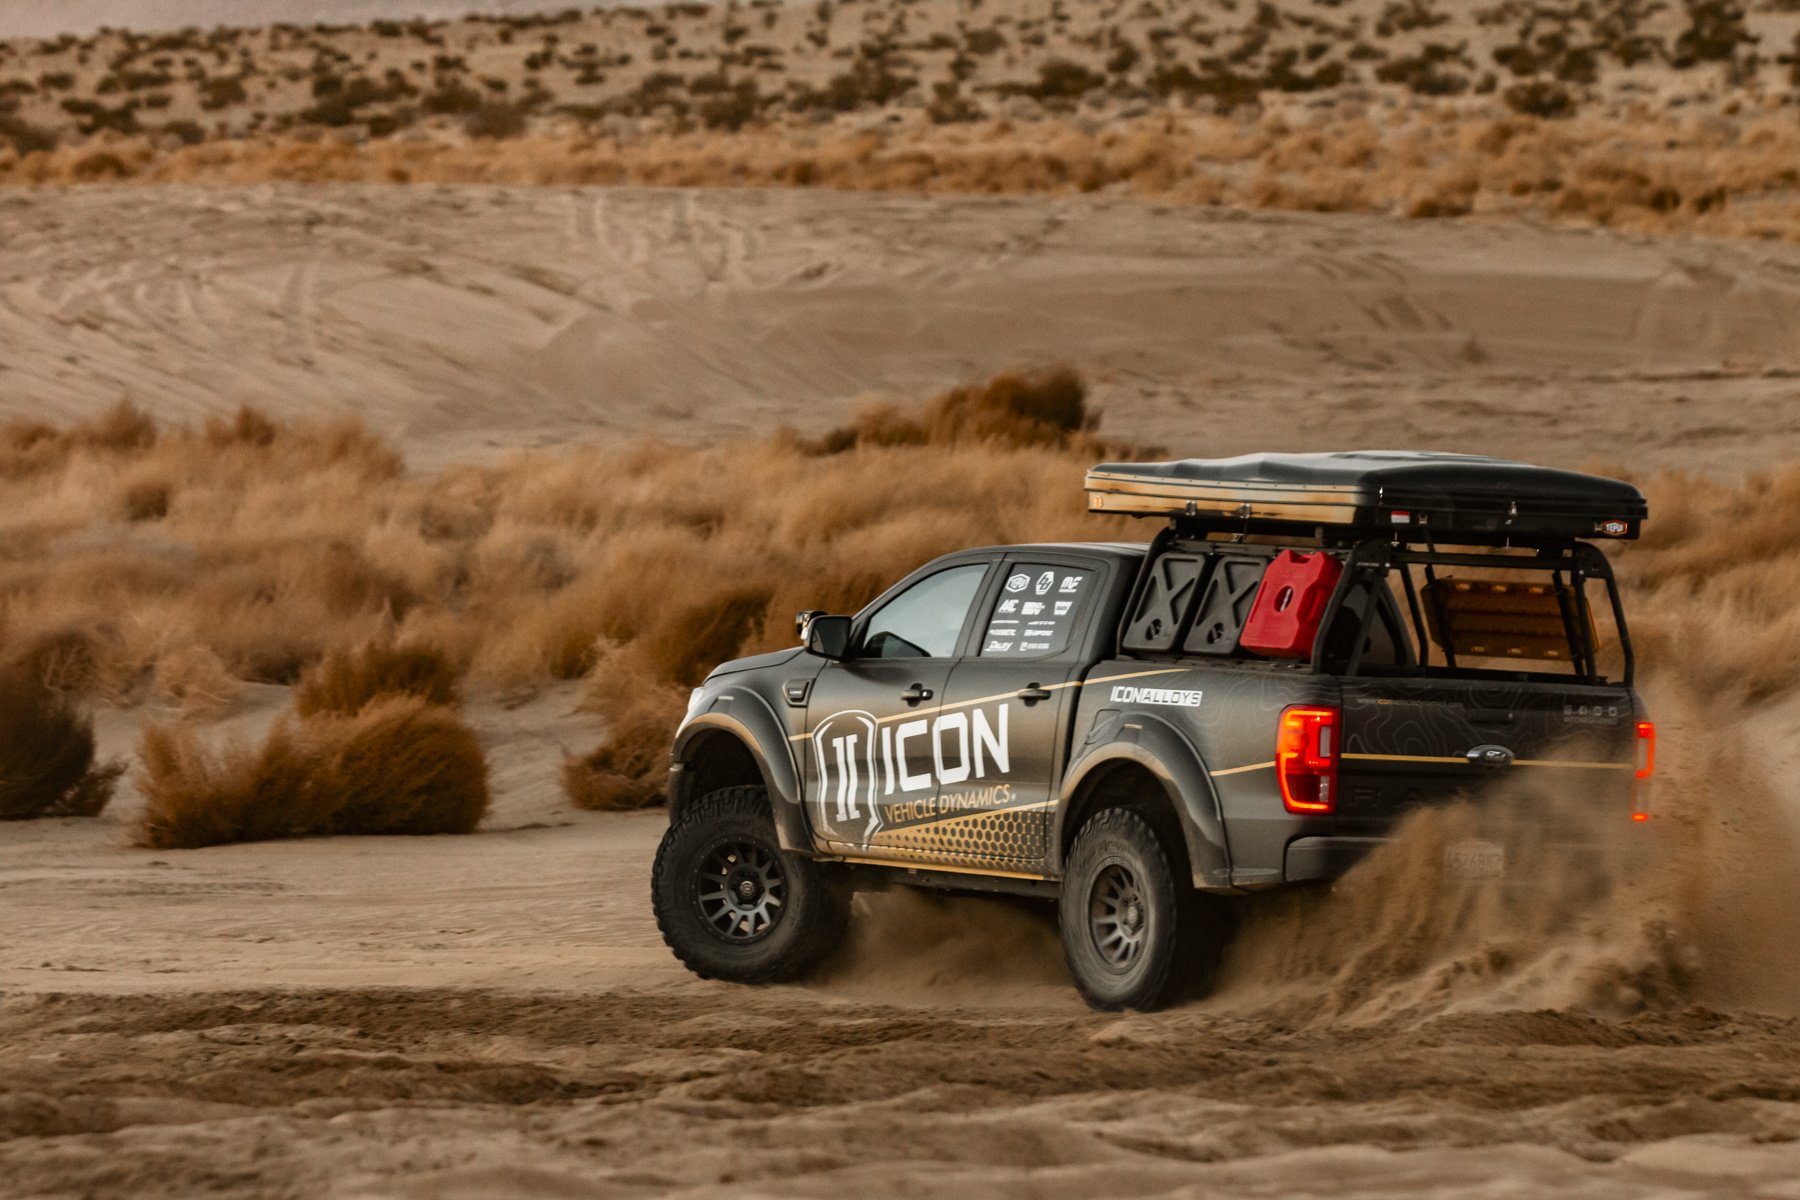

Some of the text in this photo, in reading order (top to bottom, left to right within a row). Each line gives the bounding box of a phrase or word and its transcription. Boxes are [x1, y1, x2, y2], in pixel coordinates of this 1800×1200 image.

[881, 703, 1010, 795] ICON
[883, 784, 1010, 824] VEHICLE DYNAMICS
